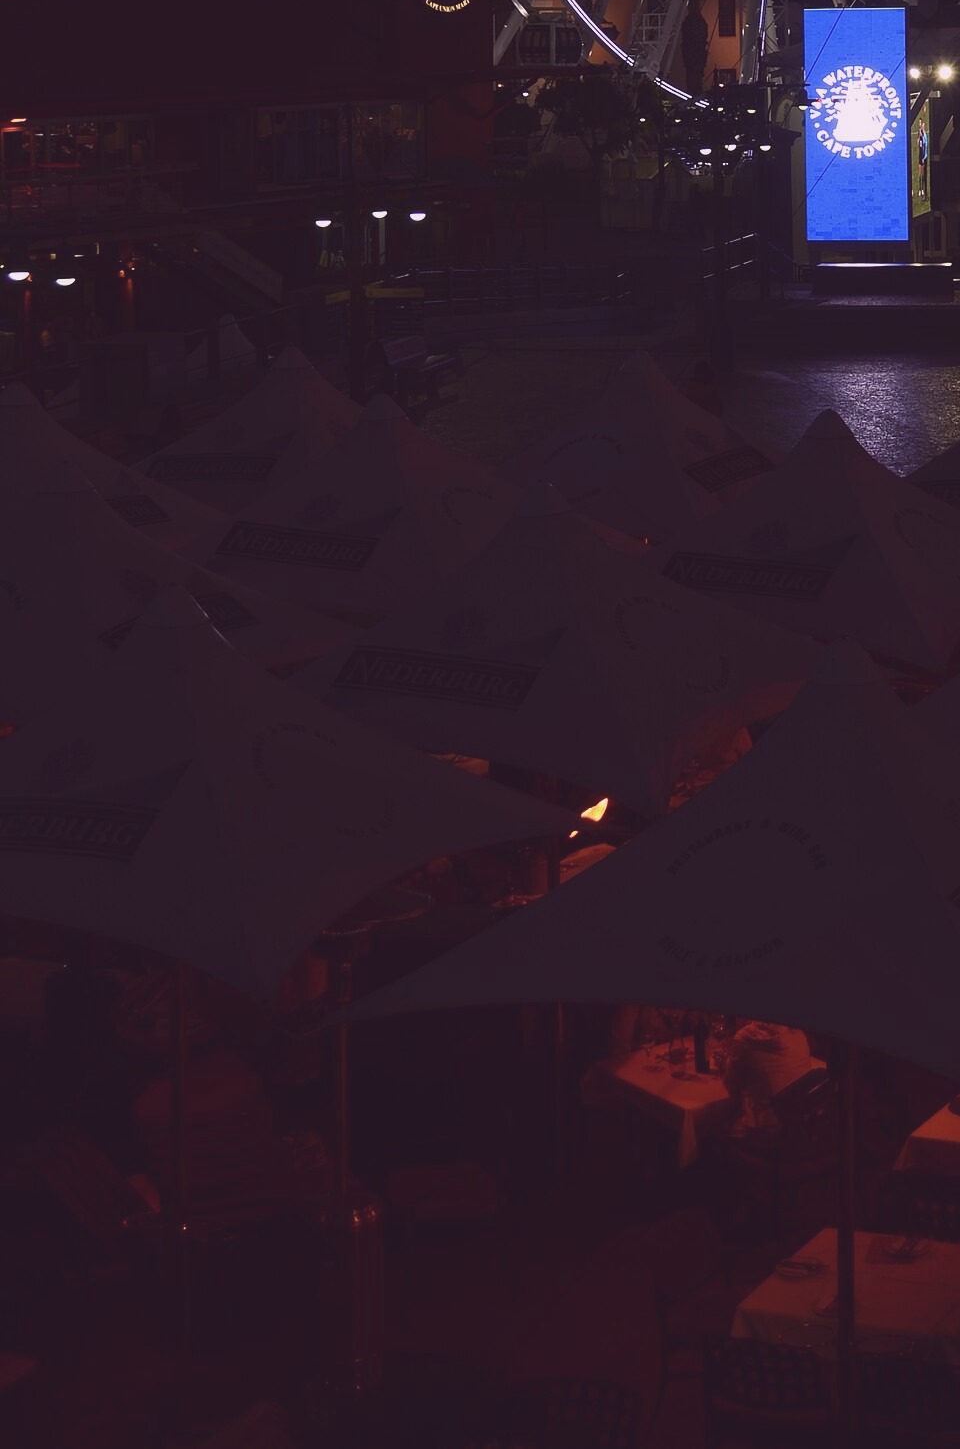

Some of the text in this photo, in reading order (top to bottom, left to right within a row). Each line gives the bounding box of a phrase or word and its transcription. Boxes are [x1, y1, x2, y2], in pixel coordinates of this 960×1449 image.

[822, 65, 902, 119] WATERFRONT
[816, 128, 896, 159] CAPE TOWN
[227, 529, 365, 563] NEDERBURG
[674, 554, 822, 592] NEDERBURG
[346, 653, 527, 700] NEDERBURG
[0, 814, 140, 847] ERBURG
[666, 819, 752, 876] RESTAURANT
[779, 821, 811, 846] WINE
[807, 843, 828, 871] BAR
